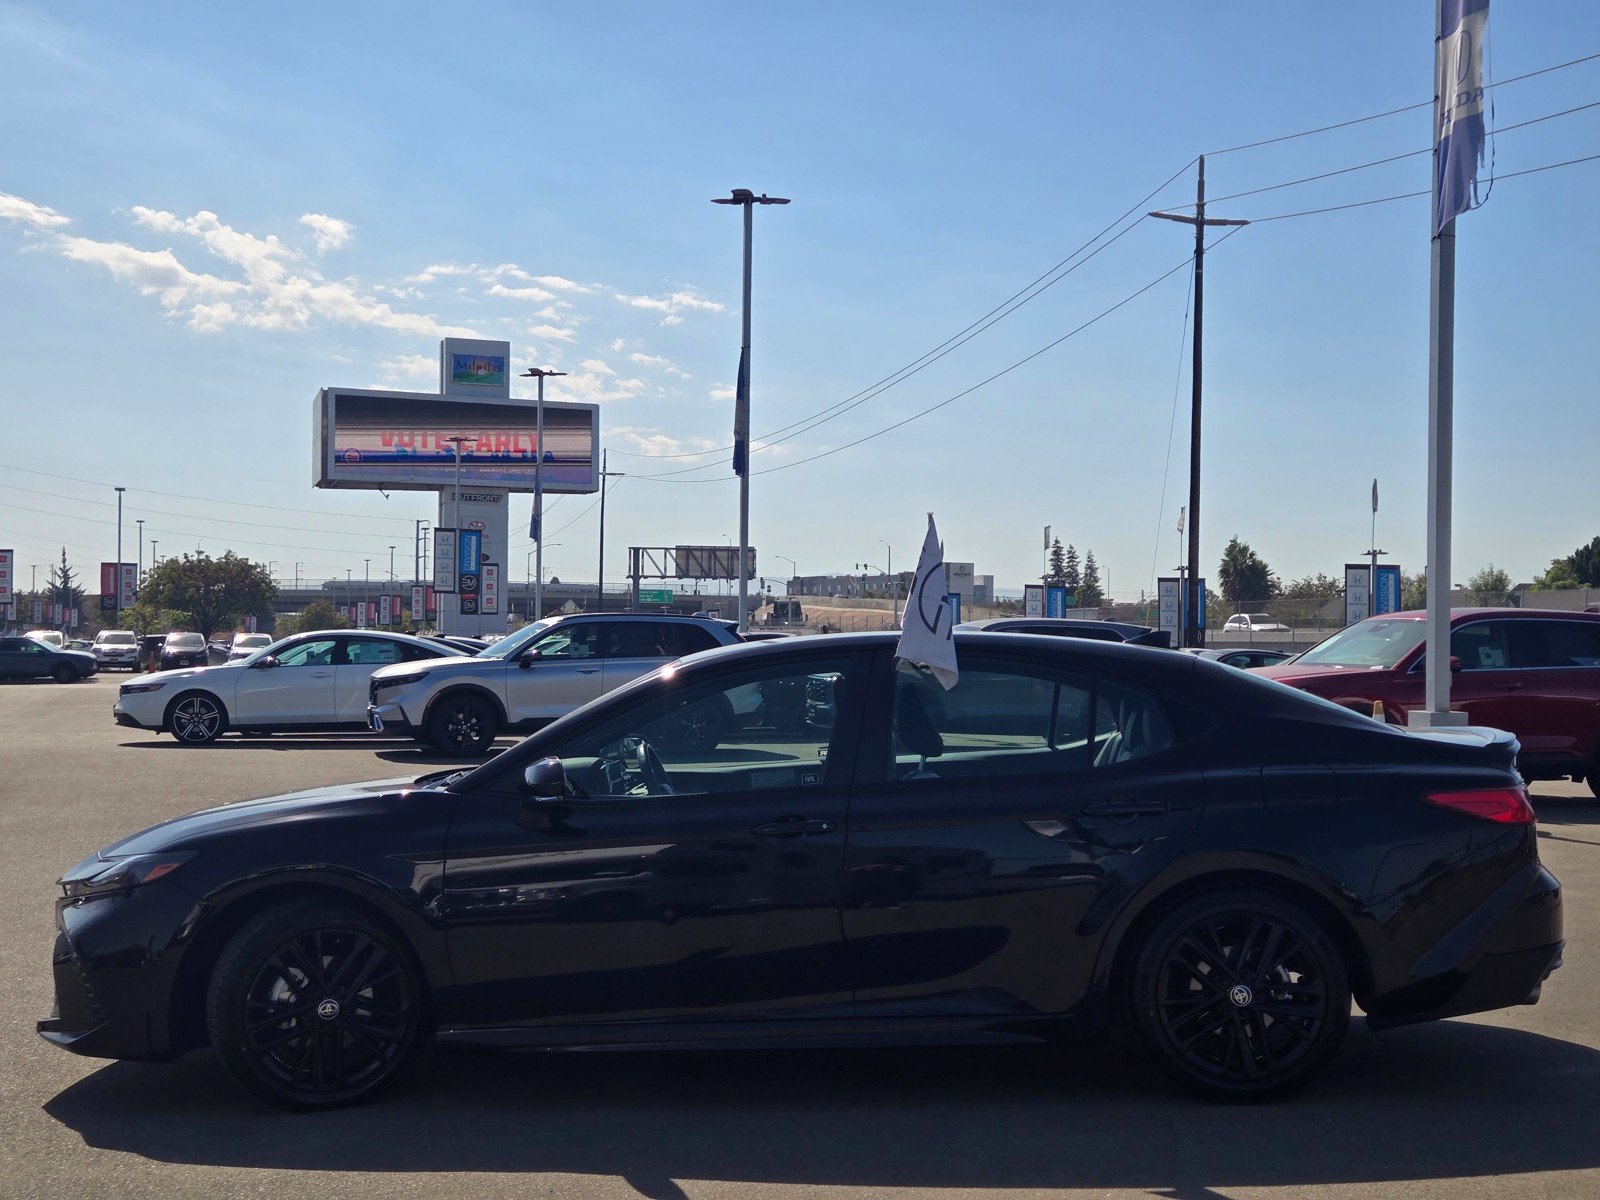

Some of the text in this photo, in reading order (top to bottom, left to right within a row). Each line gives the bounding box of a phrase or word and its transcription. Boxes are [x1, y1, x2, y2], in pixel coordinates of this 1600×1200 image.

[1440, 86, 1484, 128] HDA
[380, 431, 539, 453] VOTE EARLY
[1380, 573, 1388, 613] NVISION
